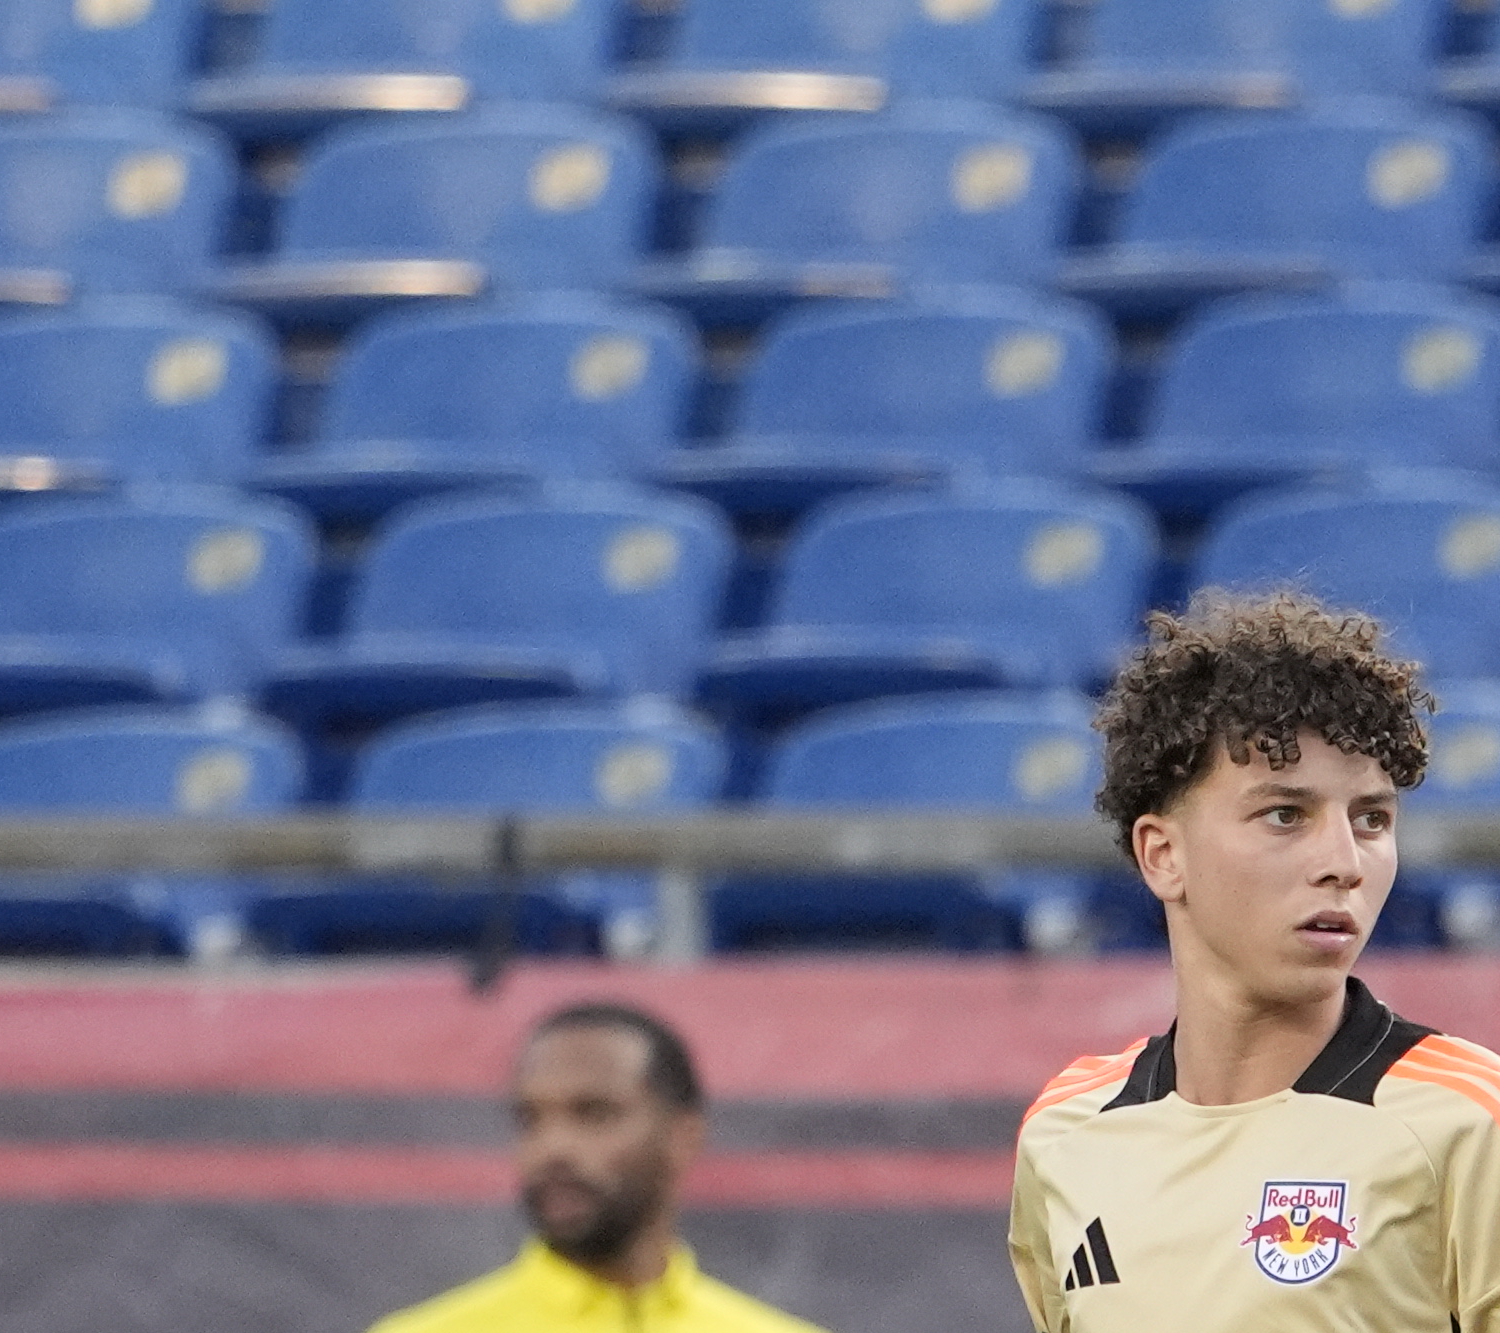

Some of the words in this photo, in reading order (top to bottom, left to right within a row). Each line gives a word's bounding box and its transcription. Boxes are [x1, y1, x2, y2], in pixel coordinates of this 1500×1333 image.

[1267, 1188, 1302, 1207] Red
[1304, 1189, 1339, 1208] Bull
[1262, 1247, 1289, 1275] NEW
[1294, 1248, 1329, 1277] YORK
